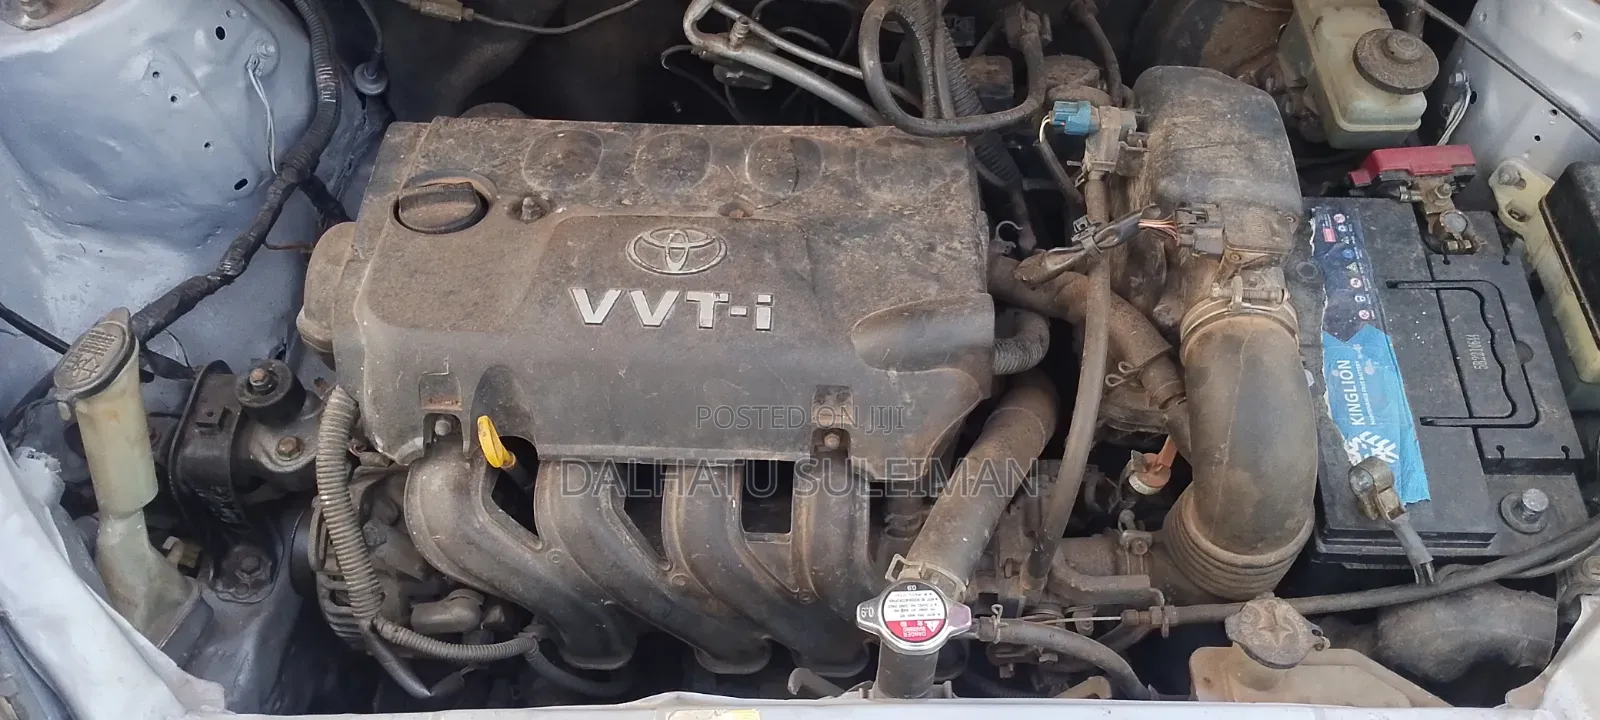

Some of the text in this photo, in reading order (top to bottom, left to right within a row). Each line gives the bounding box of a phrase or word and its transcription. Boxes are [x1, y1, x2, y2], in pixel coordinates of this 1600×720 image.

[569, 287, 774, 331] VVT-i
[1336, 360, 1366, 425] KINGLION
[860, 606, 875, 618] 0.9
